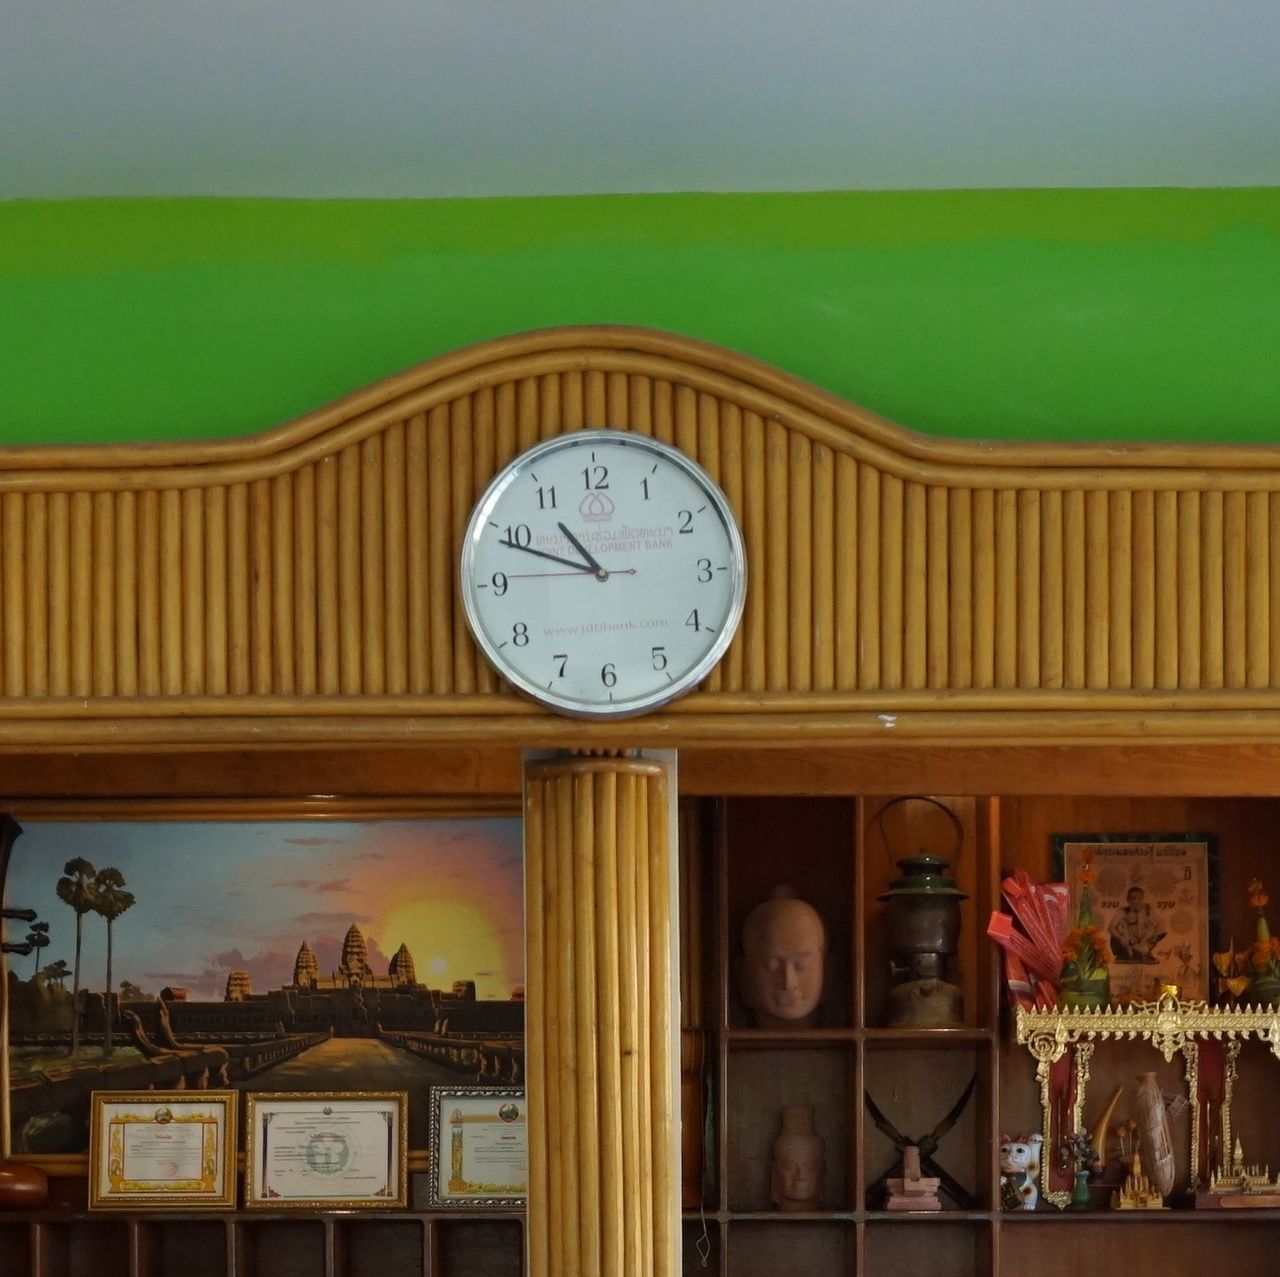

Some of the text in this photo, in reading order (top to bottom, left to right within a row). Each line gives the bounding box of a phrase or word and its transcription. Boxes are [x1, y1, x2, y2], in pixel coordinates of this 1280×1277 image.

[581, 465, 610, 490] 12
[640, 476, 650, 500] 1
[535, 485, 558, 510] 11
[677, 509, 694, 534] 2
[503, 523, 532, 548] 10
[645, 539, 673, 550] BANK
[697, 558, 713, 583] 3
[491, 571, 508, 596] 9
[685, 608, 701, 632] 4
[512, 622, 530, 647] 8
[553, 654, 569, 678] 7
[651, 646, 667, 671] 5
[601, 663, 617, 688] 6
